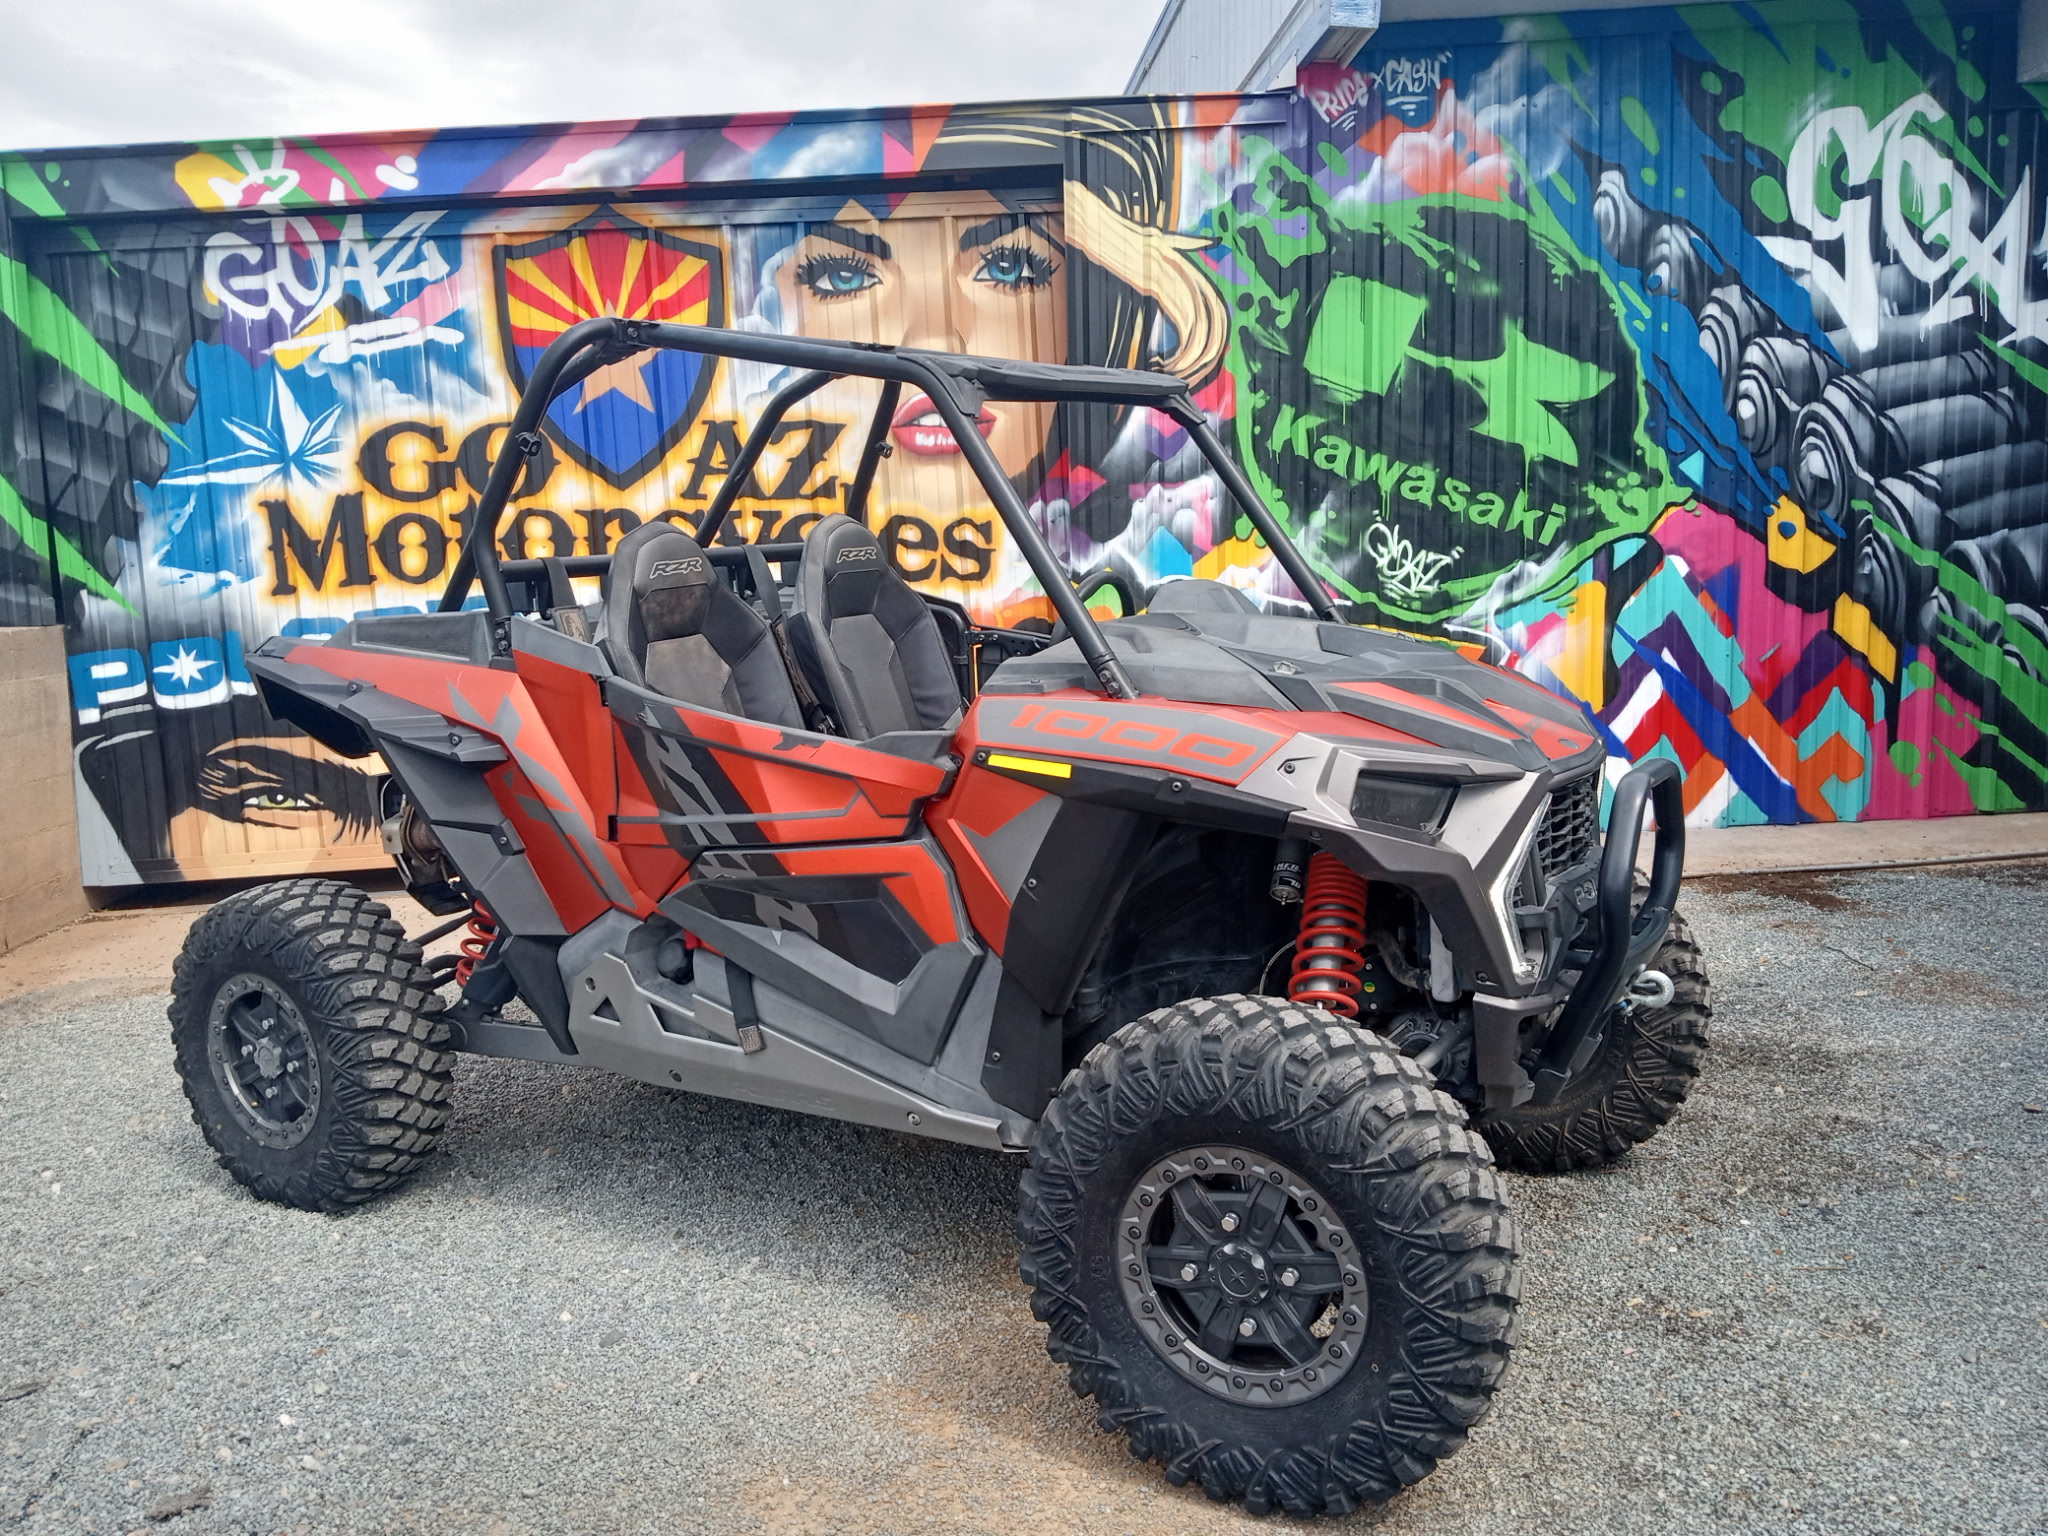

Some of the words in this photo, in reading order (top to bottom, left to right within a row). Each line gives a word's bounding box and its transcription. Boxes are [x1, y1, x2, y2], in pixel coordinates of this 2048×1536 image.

[1385, 56, 1441, 95] CASH
[356, 420, 562, 503] GO
[679, 418, 846, 500] AZ
[1266, 404, 1568, 546] Kawasaki
[258, 482, 997, 597] Mooryes
[649, 556, 703, 580] RZR
[836, 546, 877, 564] RZR
[1010, 703, 1257, 769] 1000
